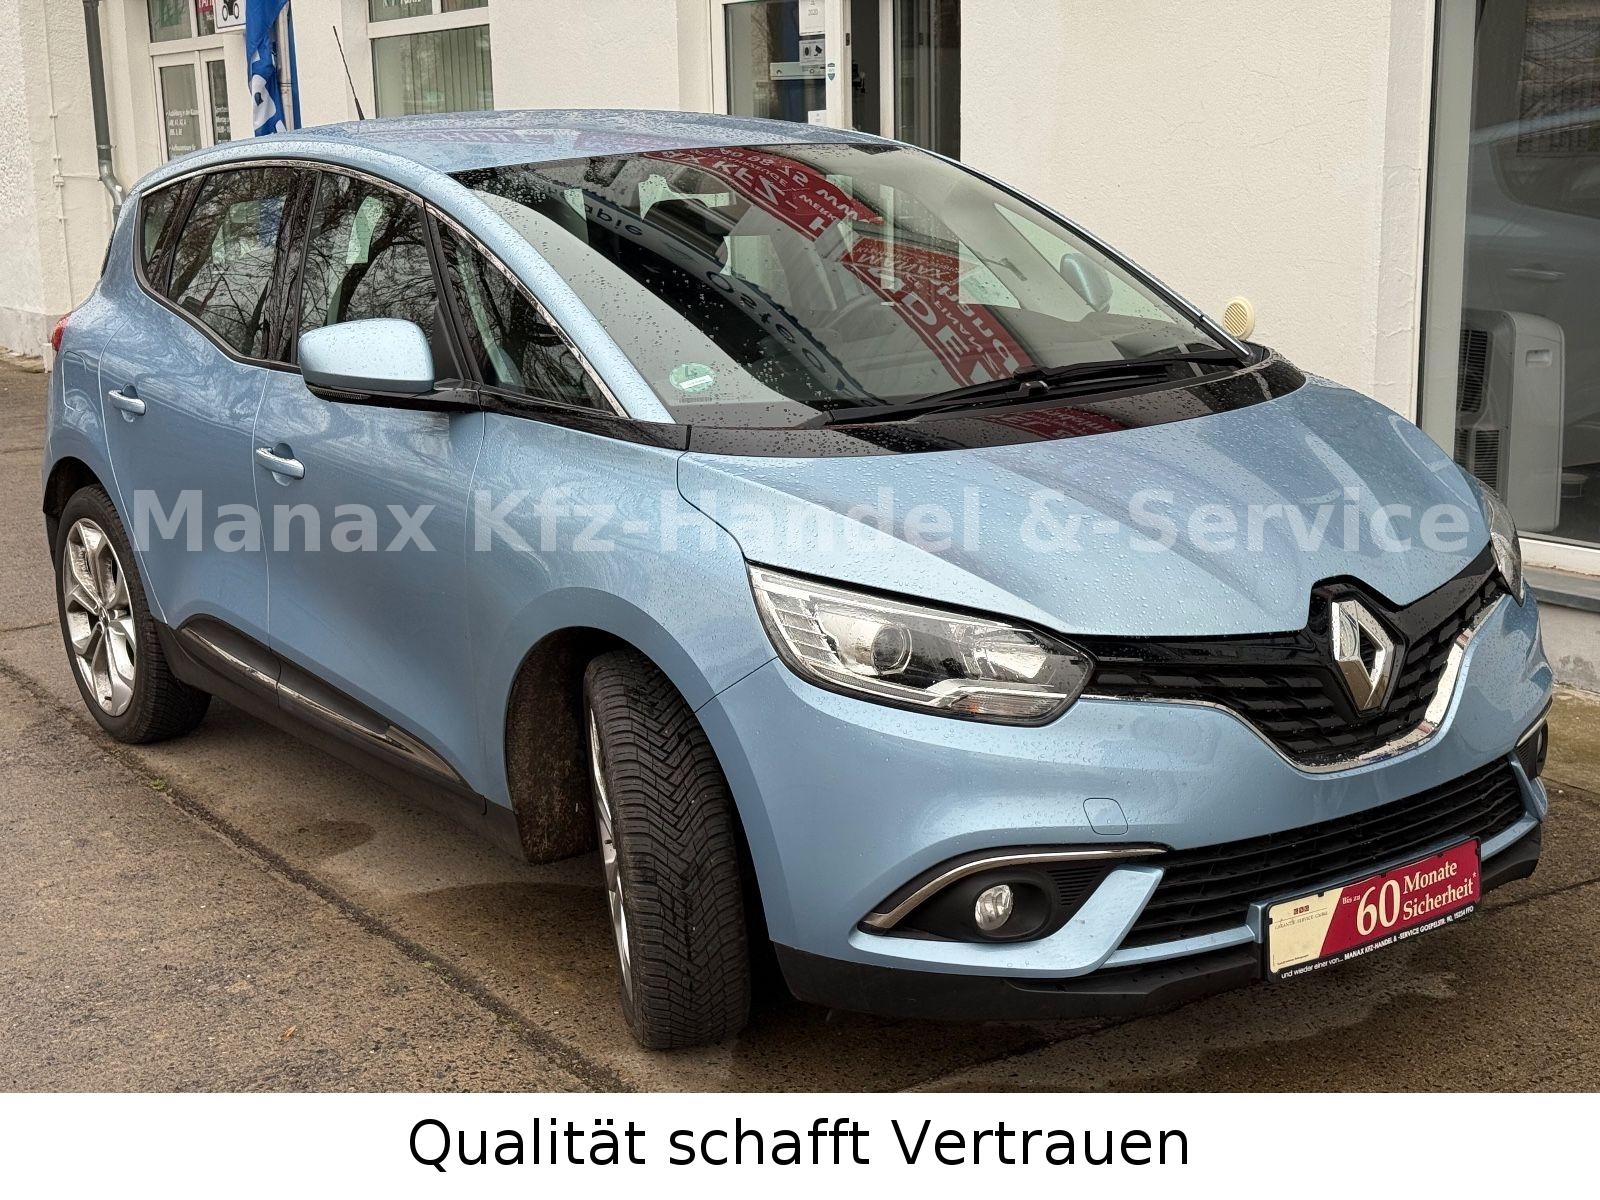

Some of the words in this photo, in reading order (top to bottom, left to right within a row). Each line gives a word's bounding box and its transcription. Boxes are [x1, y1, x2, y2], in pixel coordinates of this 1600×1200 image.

[1403, 860, 1458, 894] Monate
[1356, 879, 1401, 936] 60
[1281, 970, 1293, 979] und
[1294, 964, 1314, 974] wieder
[1314, 960, 1328, 970] einer
[1344, 948, 1365, 960] MANAX
[1364, 937, 1393, 955] KFZ-HANDEL
